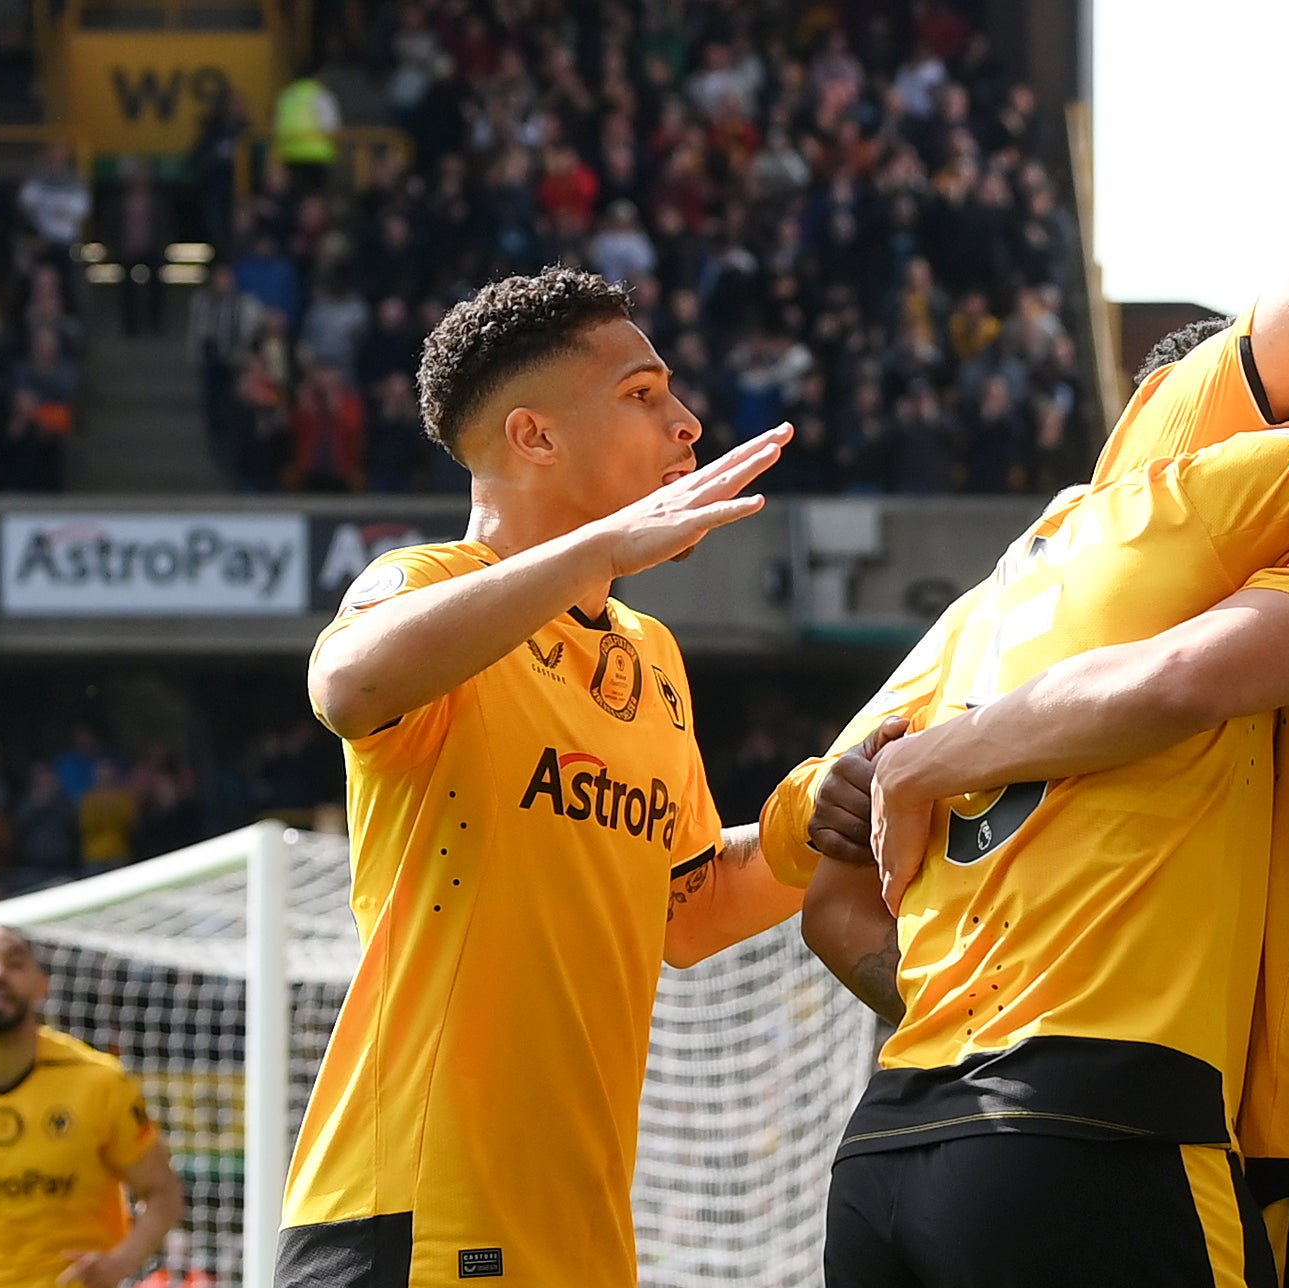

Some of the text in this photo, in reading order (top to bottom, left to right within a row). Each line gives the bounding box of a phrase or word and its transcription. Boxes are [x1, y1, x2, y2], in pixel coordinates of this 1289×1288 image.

[110, 65, 232, 122] W9
[16, 526, 293, 597] AstroPay
[519, 747, 679, 852] AstroPa
